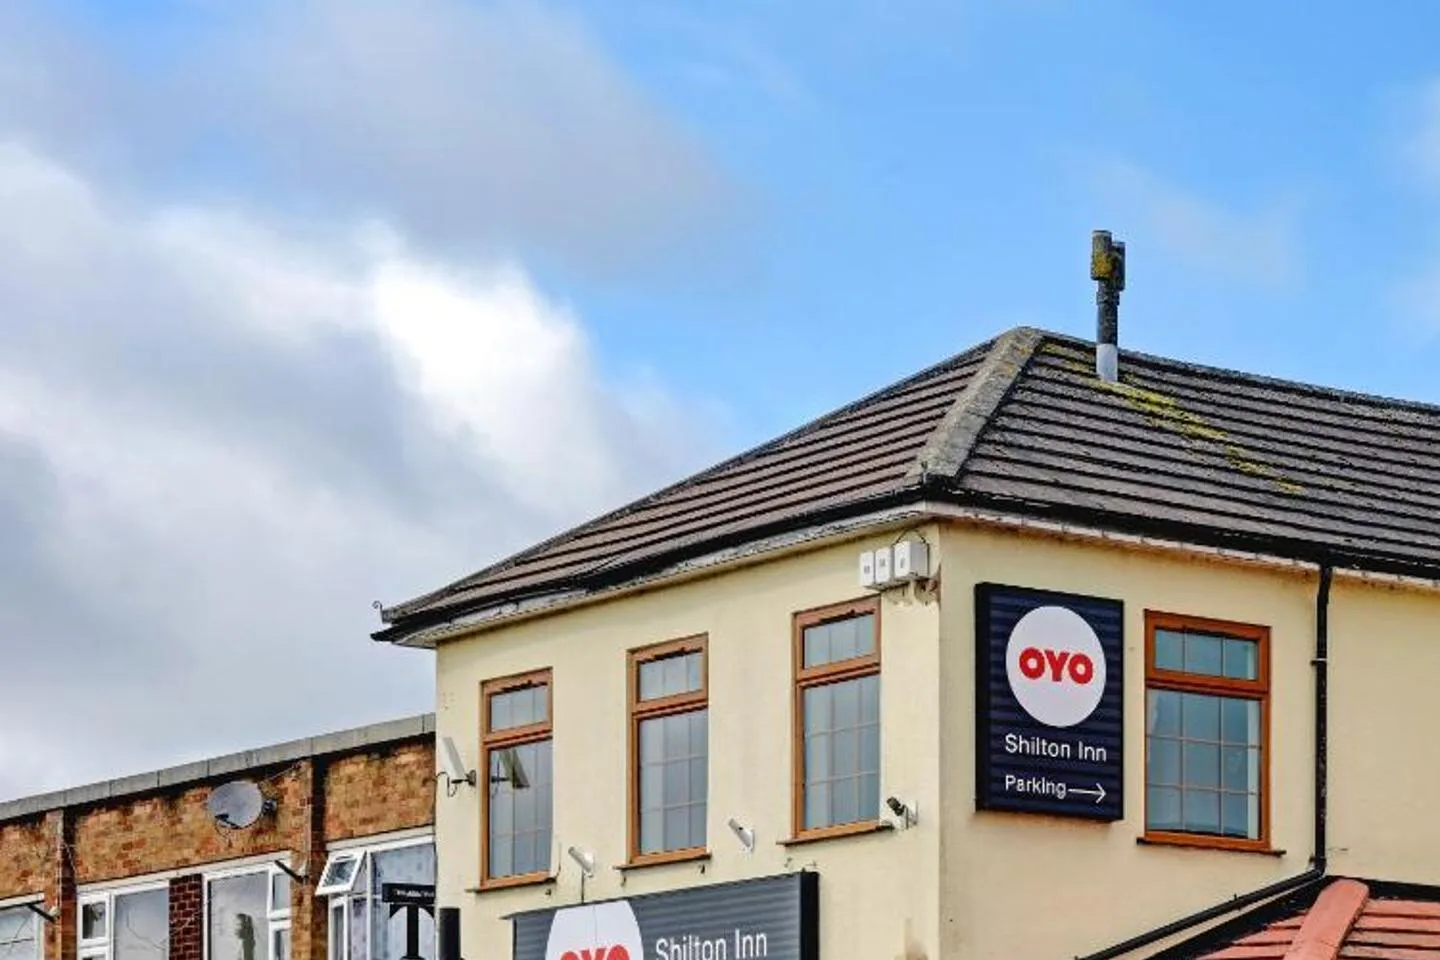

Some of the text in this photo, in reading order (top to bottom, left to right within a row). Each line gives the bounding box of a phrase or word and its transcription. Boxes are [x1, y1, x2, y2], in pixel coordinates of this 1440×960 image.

[1018, 647, 1094, 685] OYO
[1005, 733, 1107, 762] Shilton Inn
[1005, 774, 1067, 799] Parking
[735, 928, 768, 959] Inn
